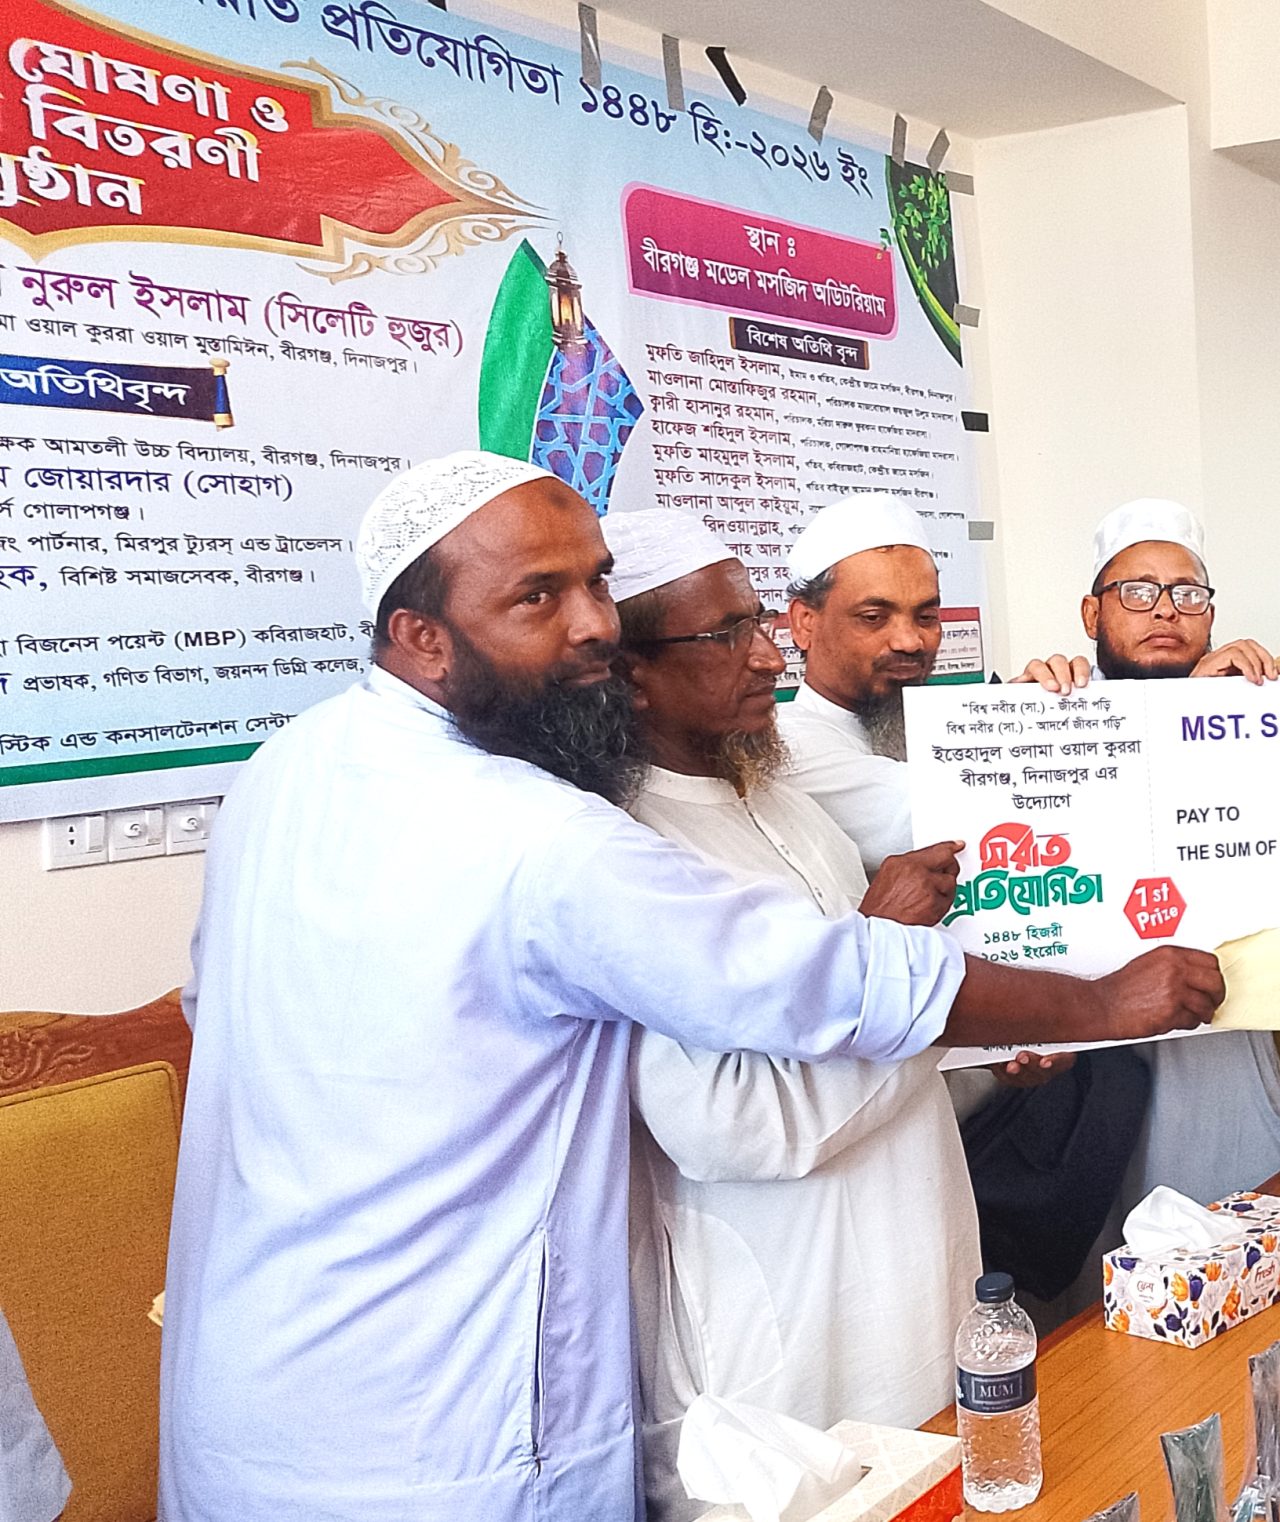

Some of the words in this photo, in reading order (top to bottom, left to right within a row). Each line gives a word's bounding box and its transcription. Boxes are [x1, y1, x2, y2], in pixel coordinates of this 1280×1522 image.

[9, 37, 231, 121] ঘোষণা
[251, 96, 289, 132] ও
[321, 0, 564, 105] প্রতিযোগিতা
[580, 77, 677, 133] ১৪৪৮
[837, 147, 873, 199] ইং
[21, 83, 262, 182] বিতরণী
[640, 237, 699, 279] বীরগঞ্জ
[703, 258, 751, 289] মডেল
[754, 269, 808, 302] মসজিদ
[15, 266, 120, 311] নুরুল
[128, 270, 251, 325] ইসলাম
[264, 291, 377, 338] (সিলেটি
[385, 315, 463, 357] হুজুর)
[24, 317, 78, 337] ওয়াল
[84, 323, 135, 346] কুররা
[141, 331, 189, 349] ওয়াল
[279, 340, 337, 367] বীরগঞ্জ,
[746, 323, 787, 349] বিশেষ
[790, 334, 833, 358] অতিথি
[645, 343, 683, 363] মুফতি
[686, 349, 735, 372] জাহিদুল
[738, 354, 785, 380] ইসলাম,
[647, 370, 704, 390] মাওলানা
[709, 378, 776, 400] মোস্তাফিজুর
[780, 387, 821, 407] রহমান,
[683, 399, 731, 419] হাসানুর
[734, 404, 778, 424] রহমান,
[651, 418, 697, 437] হাফেজ
[701, 421, 745, 443] শহিদুল
[748, 425, 795, 448] ইসলাম,
[42, 436, 128, 457] আমতলী
[134, 438, 172, 457] উচ্চ
[176, 441, 256, 466] বিদ্যালয়,
[261, 445, 324, 469] বীরগঞ্জ,
[652, 441, 693, 462] মুফতি
[697, 447, 749, 467] মাহমুদুল
[753, 448, 800, 471] ইসলাম,
[25, 466, 172, 492] জোয়ারদার
[184, 470, 292, 502] (সোহাগ)
[653, 466, 695, 486] মুফতি
[698, 471, 751, 491] সাদেকুল
[754, 472, 801, 493] ইসলাম,
[655, 493, 713, 509] মাওলানা
[717, 496, 755, 514] আব্দুল
[27, 531, 108, 554] পার্টনার,
[115, 531, 180, 555] মিরপুর
[240, 537, 272, 552] এন্ড
[58, 565, 118, 586] বিশিষ্ট
[124, 570, 239, 587] সমাজসেবক,
[15, 633, 100, 655] বিজনেস
[107, 630, 167, 650] পয়েন্ট
[174, 629, 246, 651] (MBP)
[251, 622, 354, 643] কবিরাজহাট,
[23, 673, 96, 692] প্রভাষক,
[103, 667, 149, 687] গণিত
[154, 664, 209, 684] বিভাগ,
[213, 663, 269, 679] জয়নন্দ
[273, 657, 308, 676] ডিগ্রি
[311, 658, 364, 674] কলেজ,
[991, 700, 1017, 713] নবীর
[1020, 701, 1045, 715] (সা.)
[1058, 698, 1088, 711] জীবনী
[946, 722, 966, 735] বিশ্ব
[969, 720, 994, 734] নবীর
[998, 722, 1024, 735] (সা.)
[1036, 717, 1070, 731] আদর্শে
[1072, 716, 1099, 730] জীবন
[1181, 714, 1250, 742] MST.
[60, 732, 98, 749] এন্ড
[932, 744, 1003, 764] ইত্তেহাদুল
[1008, 743, 1054, 759] ওলামা
[1059, 741, 1099, 757] ওয়াল
[1103, 739, 1142, 758] কুররা
[960, 769, 1017, 788] বীরগঞ্জ,
[1022, 766, 1089, 785] দিনাজপুর
[1095, 765, 1118, 780] এর
[1011, 793, 1072, 810] উদ্যোগে
[1176, 808, 1210, 824] PAY
[1215, 806, 1240, 822] TO
[1177, 845, 1209, 861] THE
[1214, 841, 1251, 859] SUM
[1255, 839, 1278, 855] OF
[941, 866, 1103, 927] প্রতিযোগিতা
[1136, 906, 1178, 932] Prize
[984, 930, 1021, 944] ১৪৪৮
[1025, 922, 1063, 940] হিজরী
[1022, 941, 1068, 959] ইংরেজি
[980, 1383, 1013, 1398] MUM
